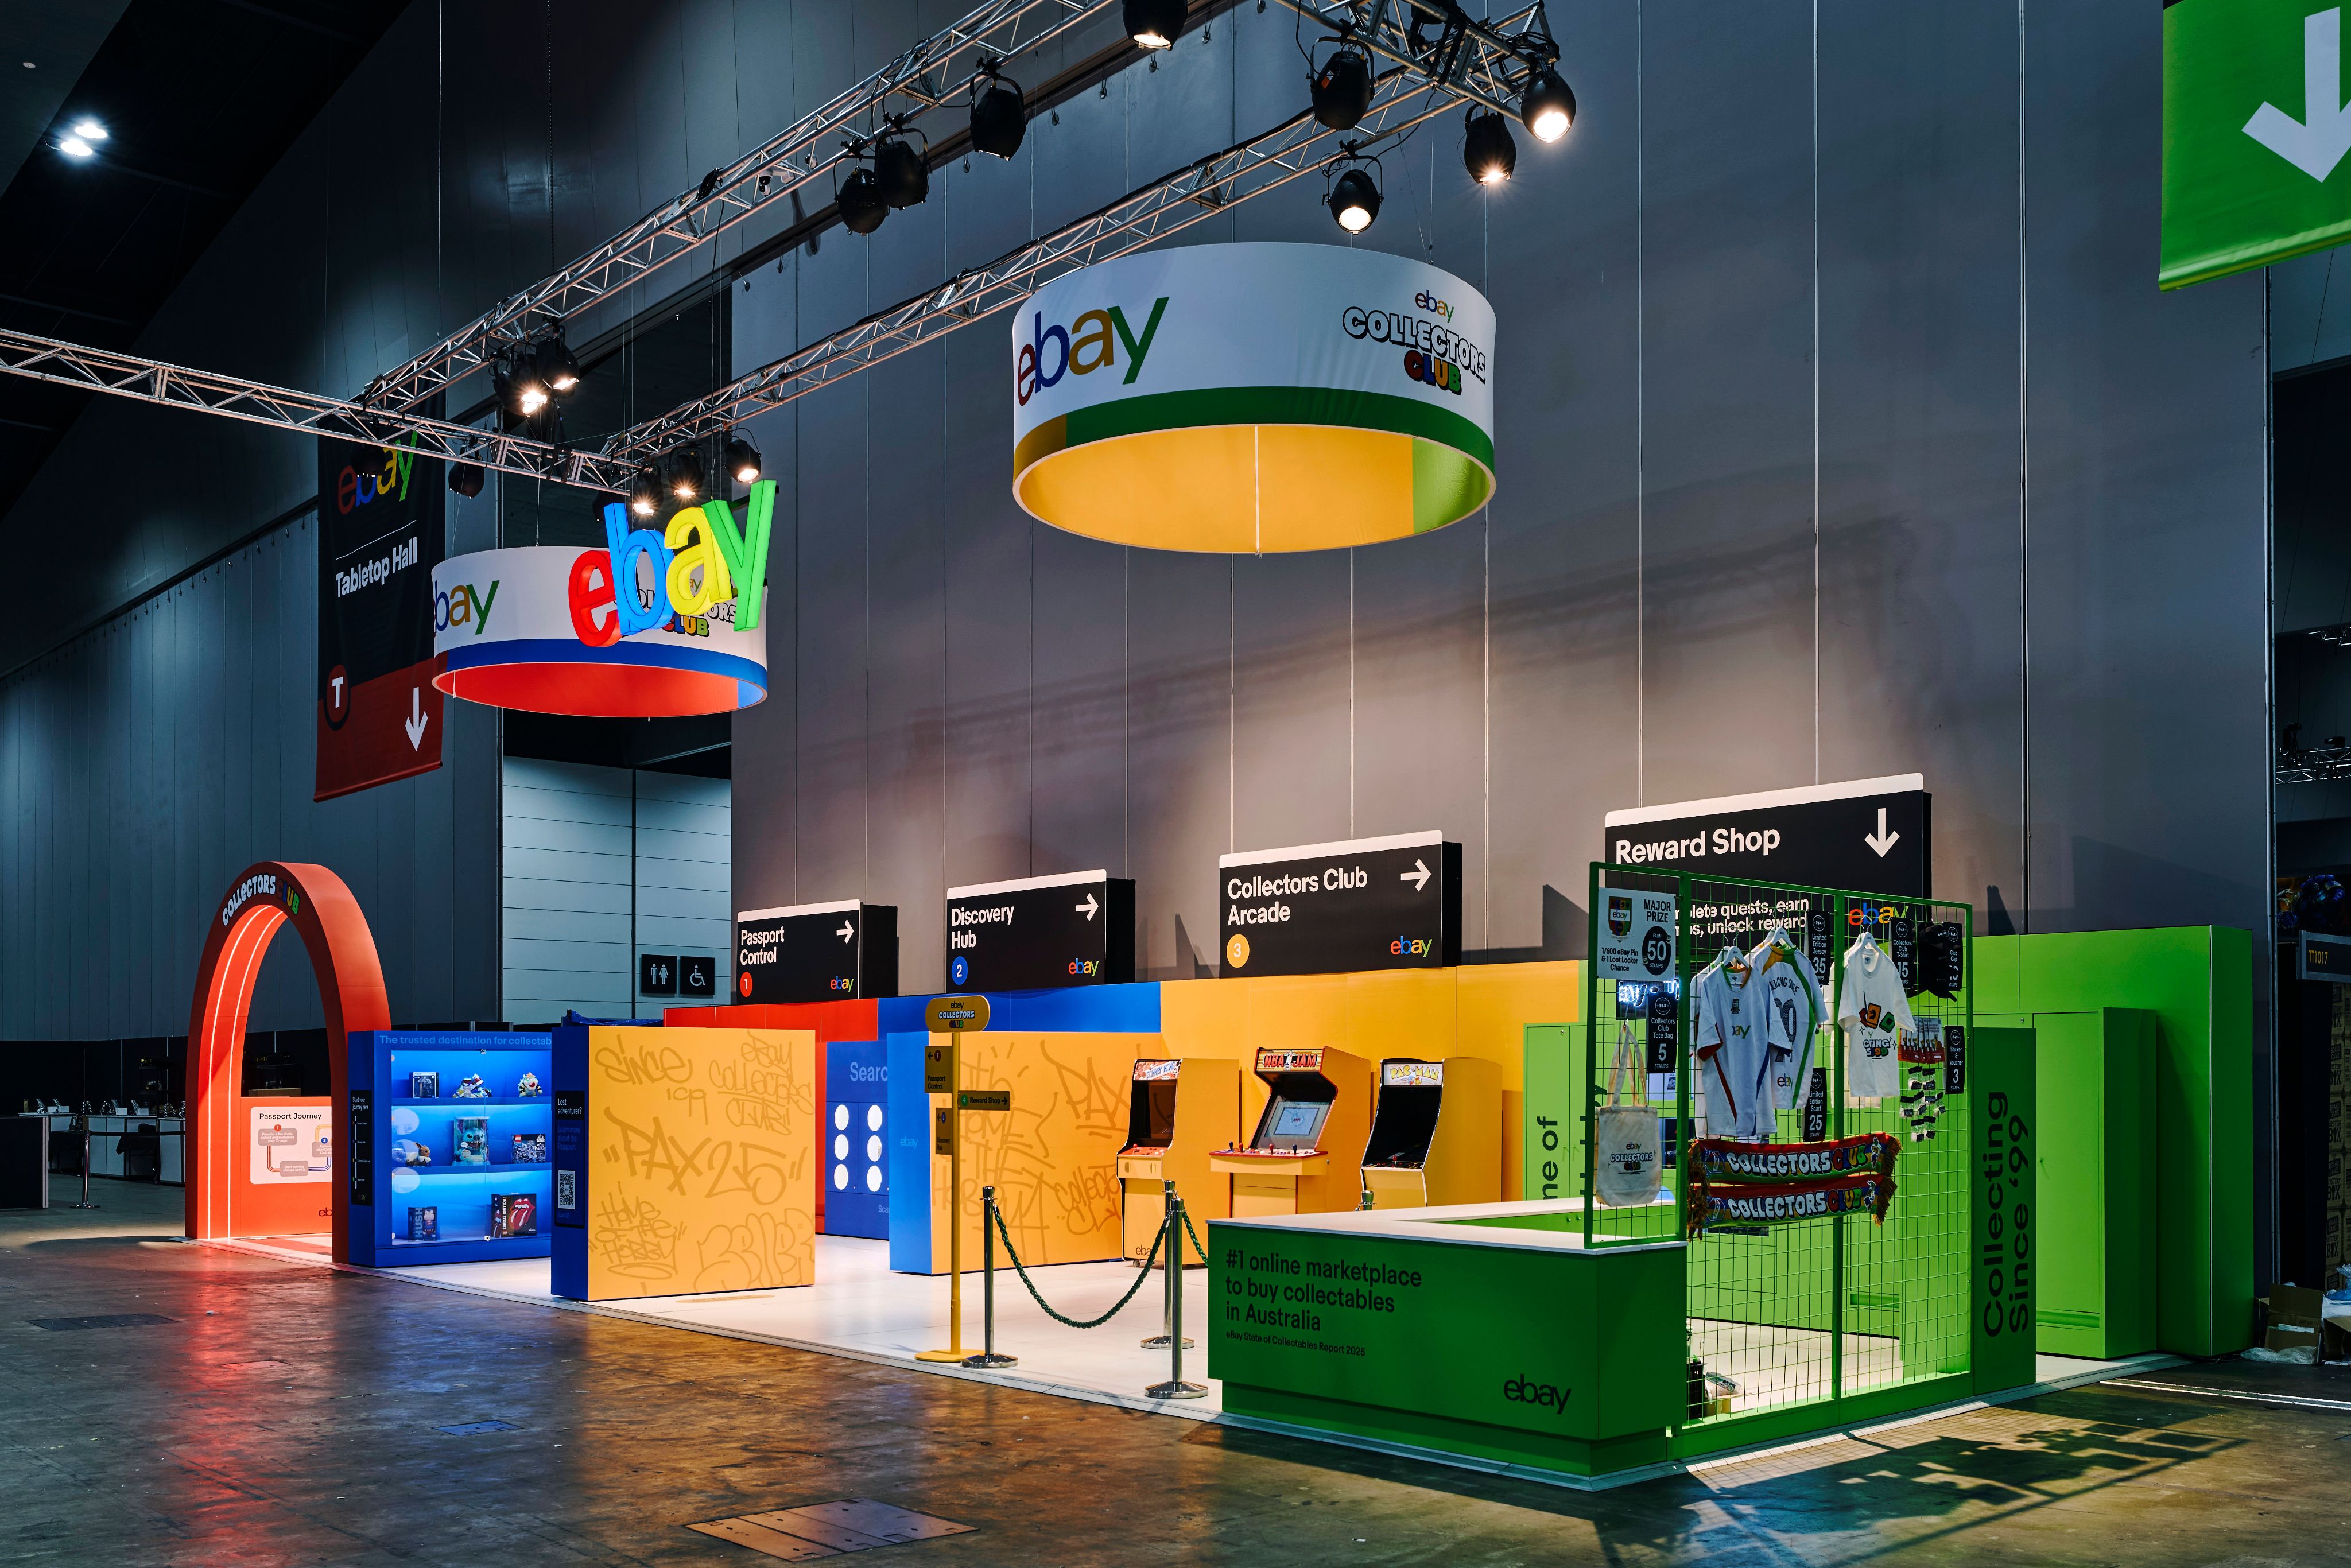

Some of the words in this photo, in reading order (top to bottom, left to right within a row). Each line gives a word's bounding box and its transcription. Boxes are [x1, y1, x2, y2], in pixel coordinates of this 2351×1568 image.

[1415, 289, 1454, 323] ebay
[1018, 297, 1170, 406] ebay
[1343, 306, 1485, 385] COLLECTORS
[1404, 350, 1462, 395] CLUB
[336, 557, 390, 598] Tabletop
[393, 537, 417, 573] Hall
[568, 480, 777, 647] ebay
[332, 677, 343, 708] T
[1616, 831, 1706, 864] Reward
[1713, 828, 1780, 856] Shop
[1228, 873, 1319, 899] Collectors
[1323, 866, 1368, 890] Club
[223, 875, 276, 926] COLLECTORS
[277, 878, 300, 915] CLUB
[1644, 899, 1671, 911] MAJOR
[1721, 899, 1773, 919] quests,
[1776, 899, 1809, 912] earn
[952, 906, 1014, 925] Discovery
[1227, 901, 1291, 926] Arcade
[1613, 910, 1627, 920] ebay
[1647, 911, 1668, 923] PRIZE
[1708, 917, 1755, 934] unlock
[741, 926, 785, 947] Passport
[952, 930, 976, 949] Hub
[740, 946, 777, 965] Control
[1233, 942, 1242, 958] 3
[1390, 936, 1432, 957] ebay
[1647, 941, 1666, 961] 50
[1813, 948, 1826, 956] Jersey
[1813, 957, 1826, 973] 35
[2309, 950, 2328, 964] TT1017
[956, 964, 962, 977] 2
[1068, 958, 1099, 976] ebay
[744, 979, 747, 989] 1
[831, 976, 854, 992] ebay
[951, 1001, 964, 1009] ebay
[938, 1010, 975, 1020] COLLECTORS
[949, 1020, 964, 1028] CLUB
[379, 1035, 398, 1044] The
[400, 1035, 436, 1044] trusted
[438, 1035, 491, 1045] destination
[494, 1037, 507, 1045] for
[1264, 1054, 1284, 1068] NBA
[1293, 1054, 1318, 1068] JAM
[1658, 1043, 1667, 1061] 5
[928, 1075, 946, 1083] Passport
[1390, 1065, 1440, 1081] PAC-MAN
[1953, 1069, 1959, 1084] 3
[1809, 1115, 1822, 1131] 25
[900, 1136, 918, 1148] ebay
[937, 1136, 950, 1144] Discovery
[1537, 1116, 1558, 1151] of
[1626, 1142, 1641, 1151] ebay
[1611, 1152, 1653, 1162] COLLECTORS
[1726, 1150, 1832, 1177] COLLECTORS
[1832, 1144, 1868, 1172] CLUB
[1727, 1190, 1828, 1221] COLLECTORS
[1828, 1187, 1863, 1213] CLUB
[414, 1207, 424, 1238] HUSH
[1983, 1092, 2008, 1337] Collecting
[1226, 1249, 1244, 1270] #1
[1250, 1253, 1301, 1275] online
[1306, 1259, 1422, 1287] marketplace
[2009, 1202, 2029, 1333] Since
[1226, 1275, 1242, 1295] to
[1248, 1277, 1279, 1304] buy
[1283, 1283, 1395, 1313] collectables
[1226, 1301, 1240, 1321] in
[1245, 1303, 1321, 1332] Australia
[1226, 1330, 1243, 1342] eBay
[1244, 1332, 1262, 1344] State
[1263, 1334, 1271, 1344] of
[1272, 1336, 1318, 1350] Collectables
[1319, 1342, 1345, 1355] Report
[1346, 1345, 1365, 1357] 2025
[1504, 1373, 1572, 1415] ebay
